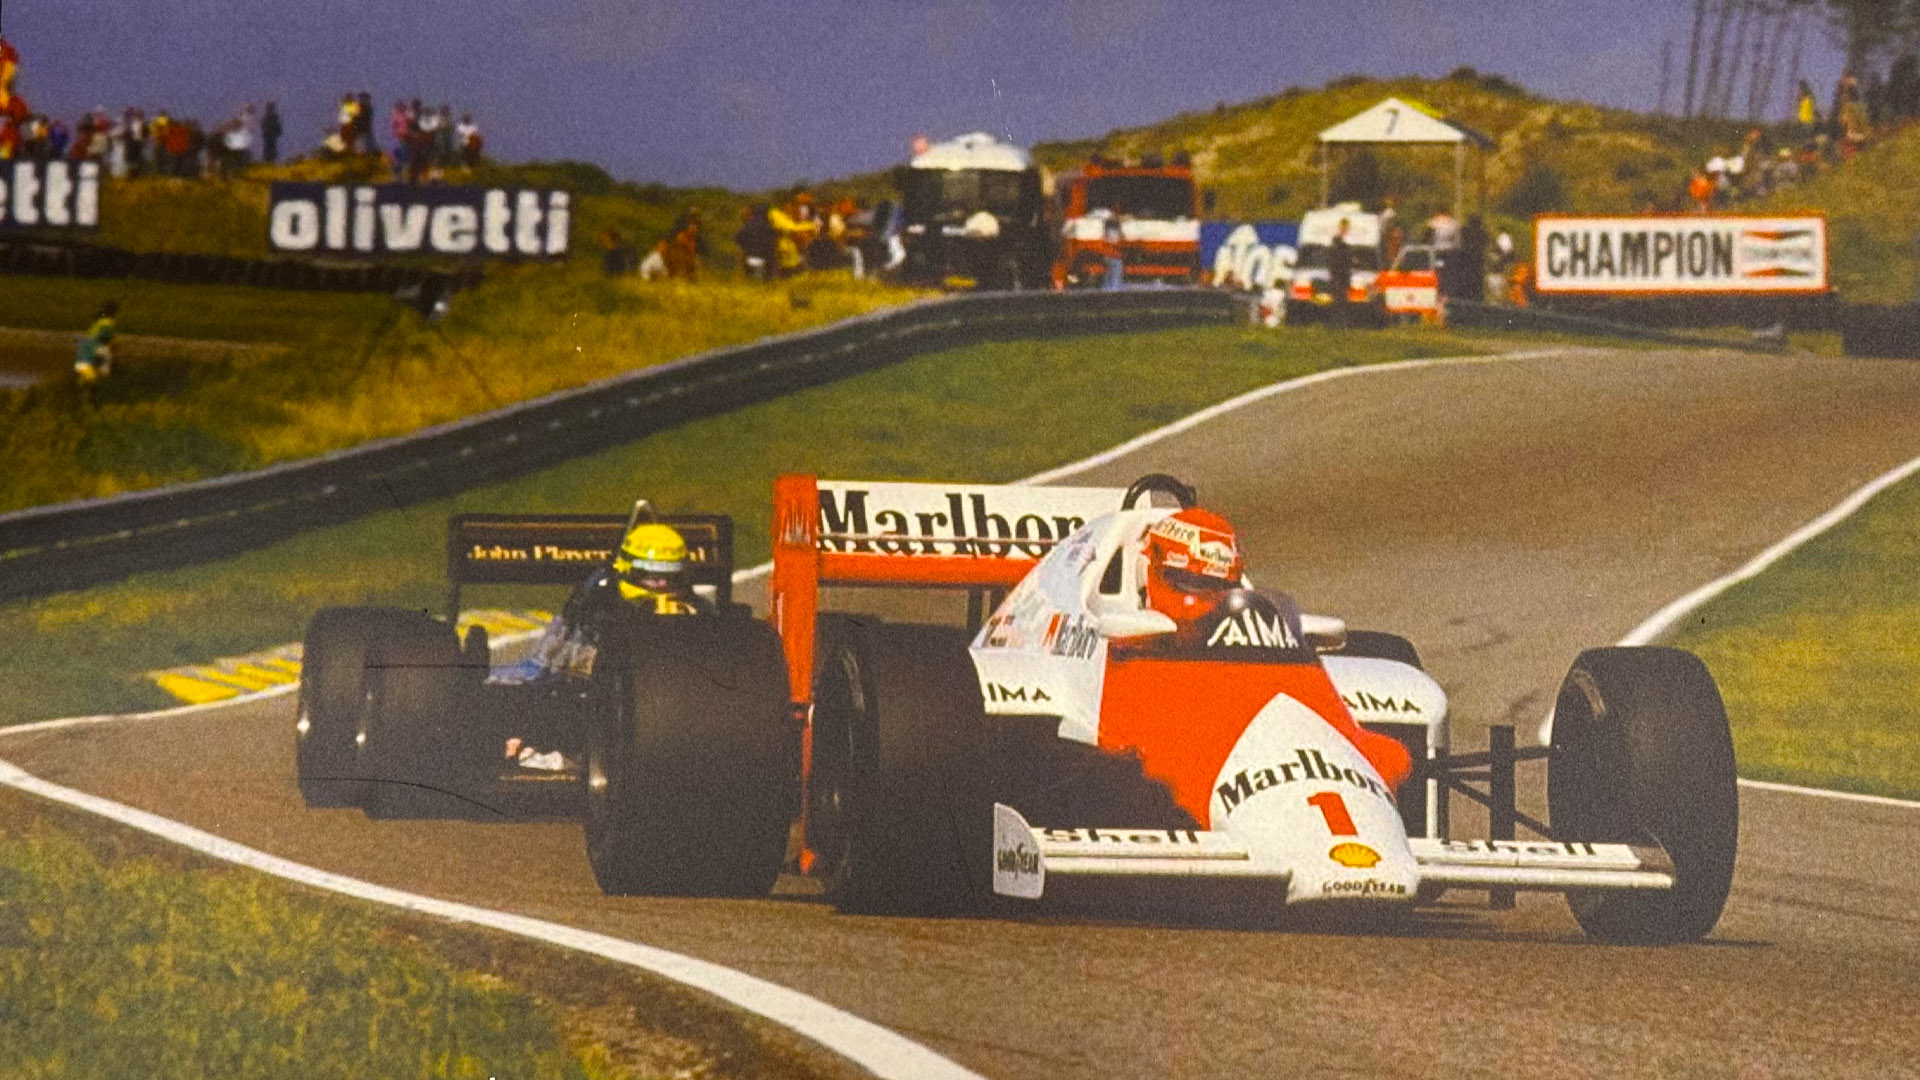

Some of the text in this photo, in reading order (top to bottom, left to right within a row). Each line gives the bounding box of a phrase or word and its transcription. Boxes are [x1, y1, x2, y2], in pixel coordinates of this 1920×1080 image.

[0, 160, 99, 226] tti
[270, 188, 570, 254] olivetti
[1546, 230, 1733, 277] CHAMPION
[818, 489, 1086, 559] Marlbor
[1307, 792, 1358, 836] 1
